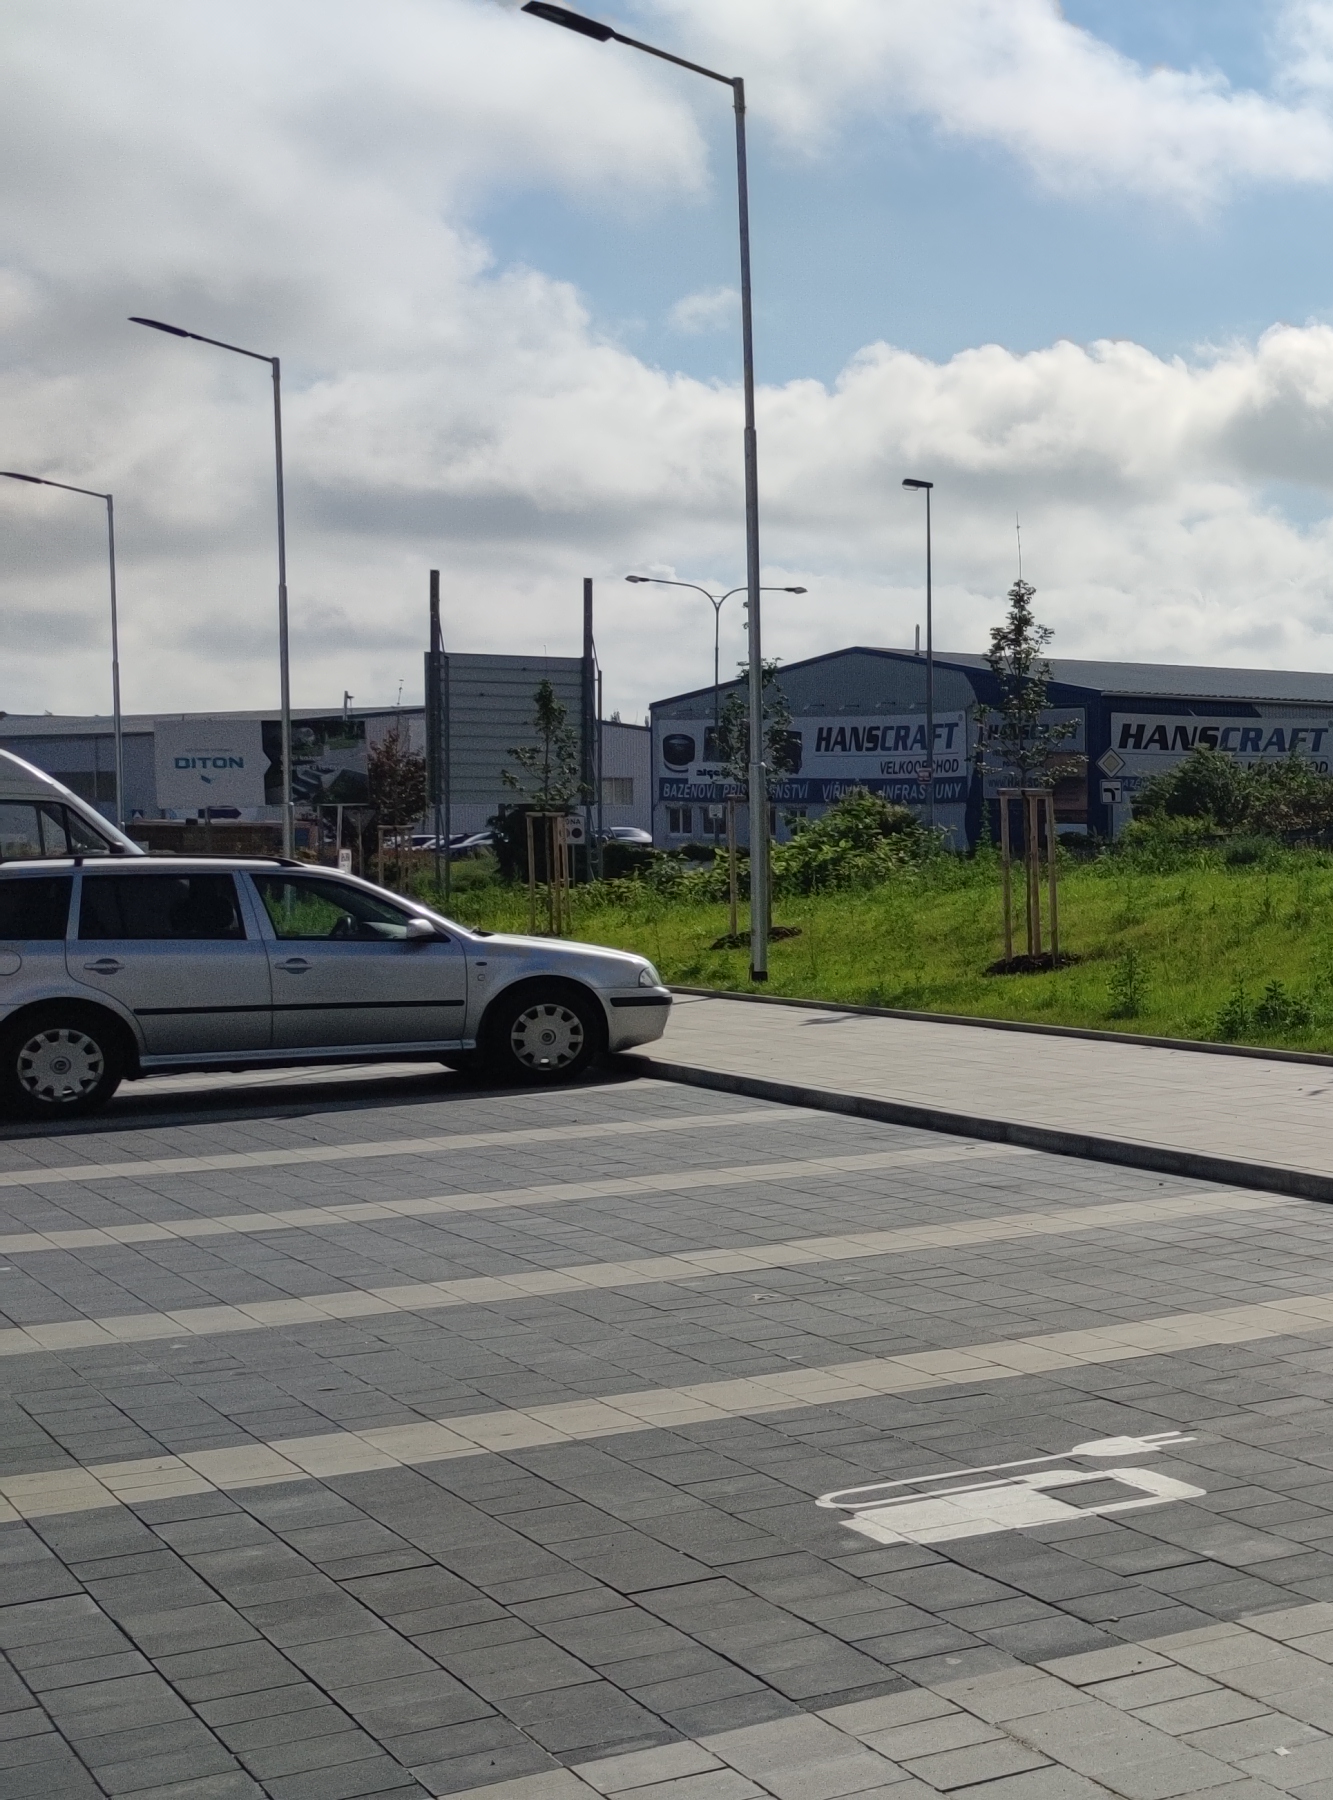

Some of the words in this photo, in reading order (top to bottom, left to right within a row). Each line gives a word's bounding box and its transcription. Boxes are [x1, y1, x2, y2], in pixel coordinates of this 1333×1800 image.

[815, 722, 959, 752] HANSCRAFT
[1118, 723, 1329, 752] HANSCRAFT
[174, 757, 244, 770] DITON
[882, 782, 962, 800] INFRASUNY
